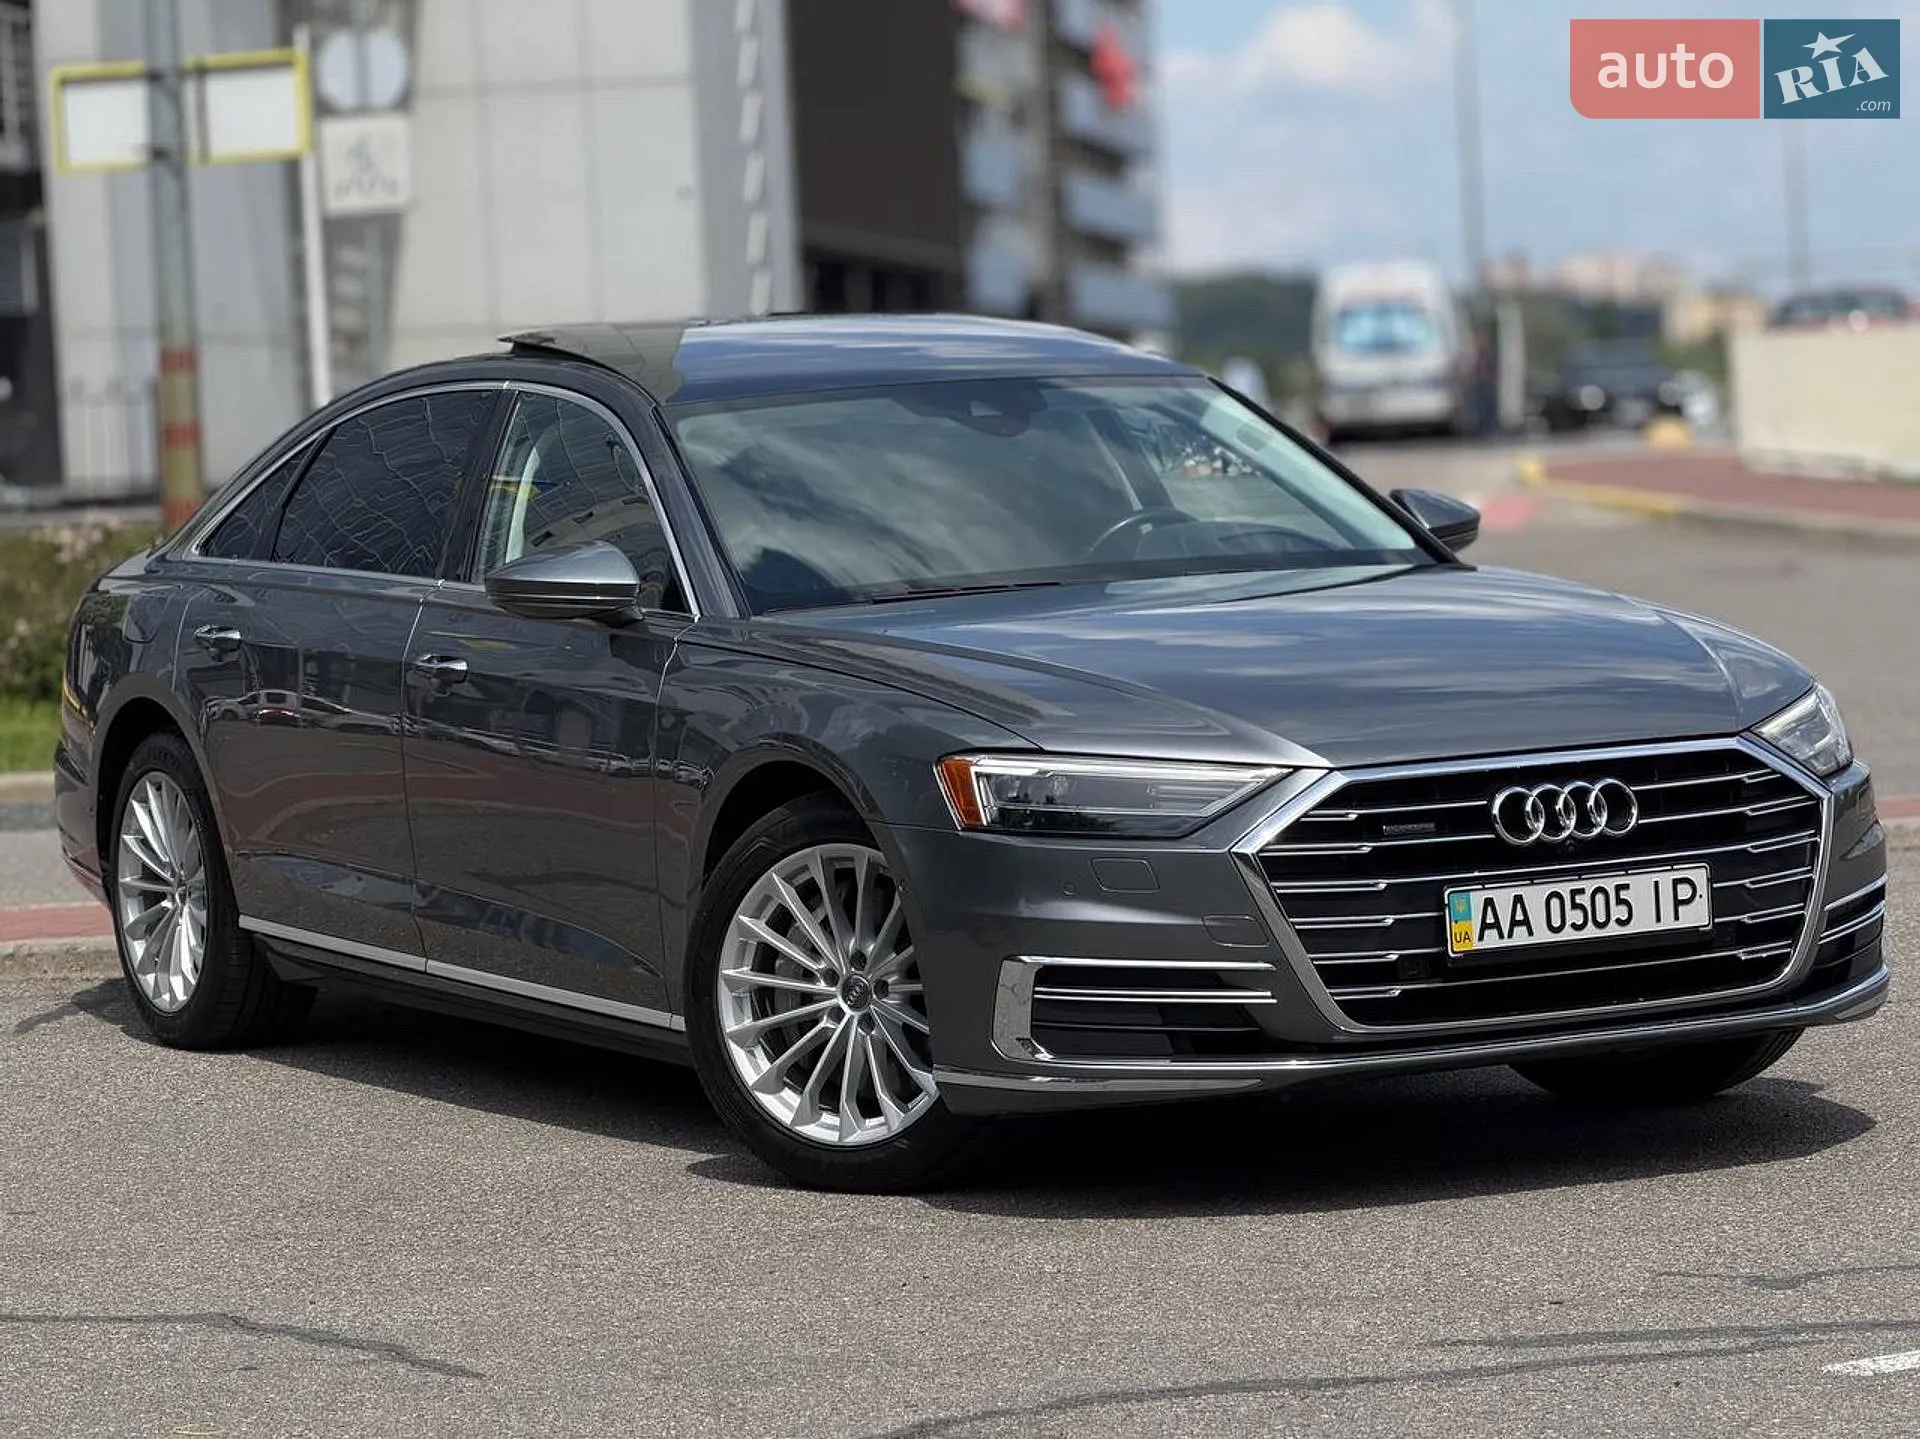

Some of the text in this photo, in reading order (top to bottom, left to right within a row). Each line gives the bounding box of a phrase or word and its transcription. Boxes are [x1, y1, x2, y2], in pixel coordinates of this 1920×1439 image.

[1478, 893, 1534, 942] AA
[1545, 883, 1633, 934] 0505
[1454, 930, 1471, 943] UA
